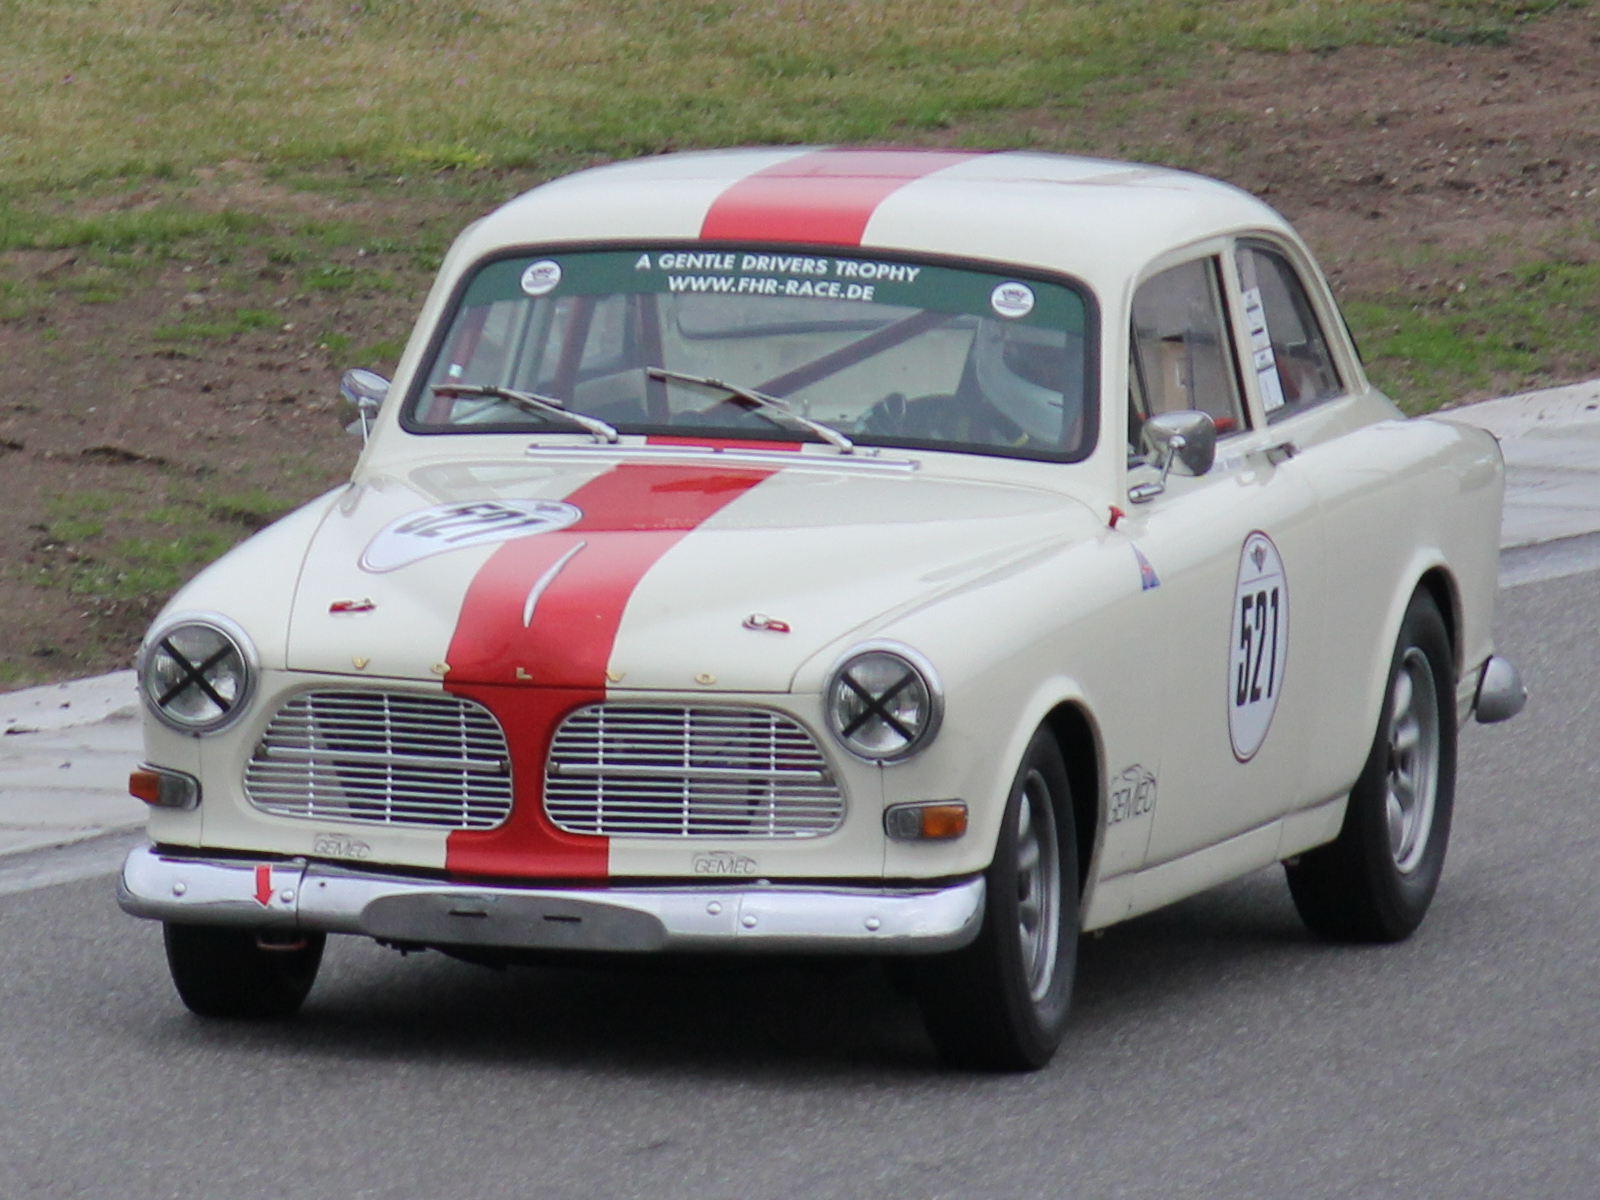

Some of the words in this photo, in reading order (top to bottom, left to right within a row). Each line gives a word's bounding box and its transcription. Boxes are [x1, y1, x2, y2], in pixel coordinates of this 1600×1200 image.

[635, 253, 651, 269] A
[658, 253, 735, 269] GENTLE
[741, 254, 829, 273] DRIVERS
[835, 260, 920, 282] TROPHY
[668, 275, 876, 301] WWW.FHR-RACE.DE
[1236, 586, 1279, 707] 521
